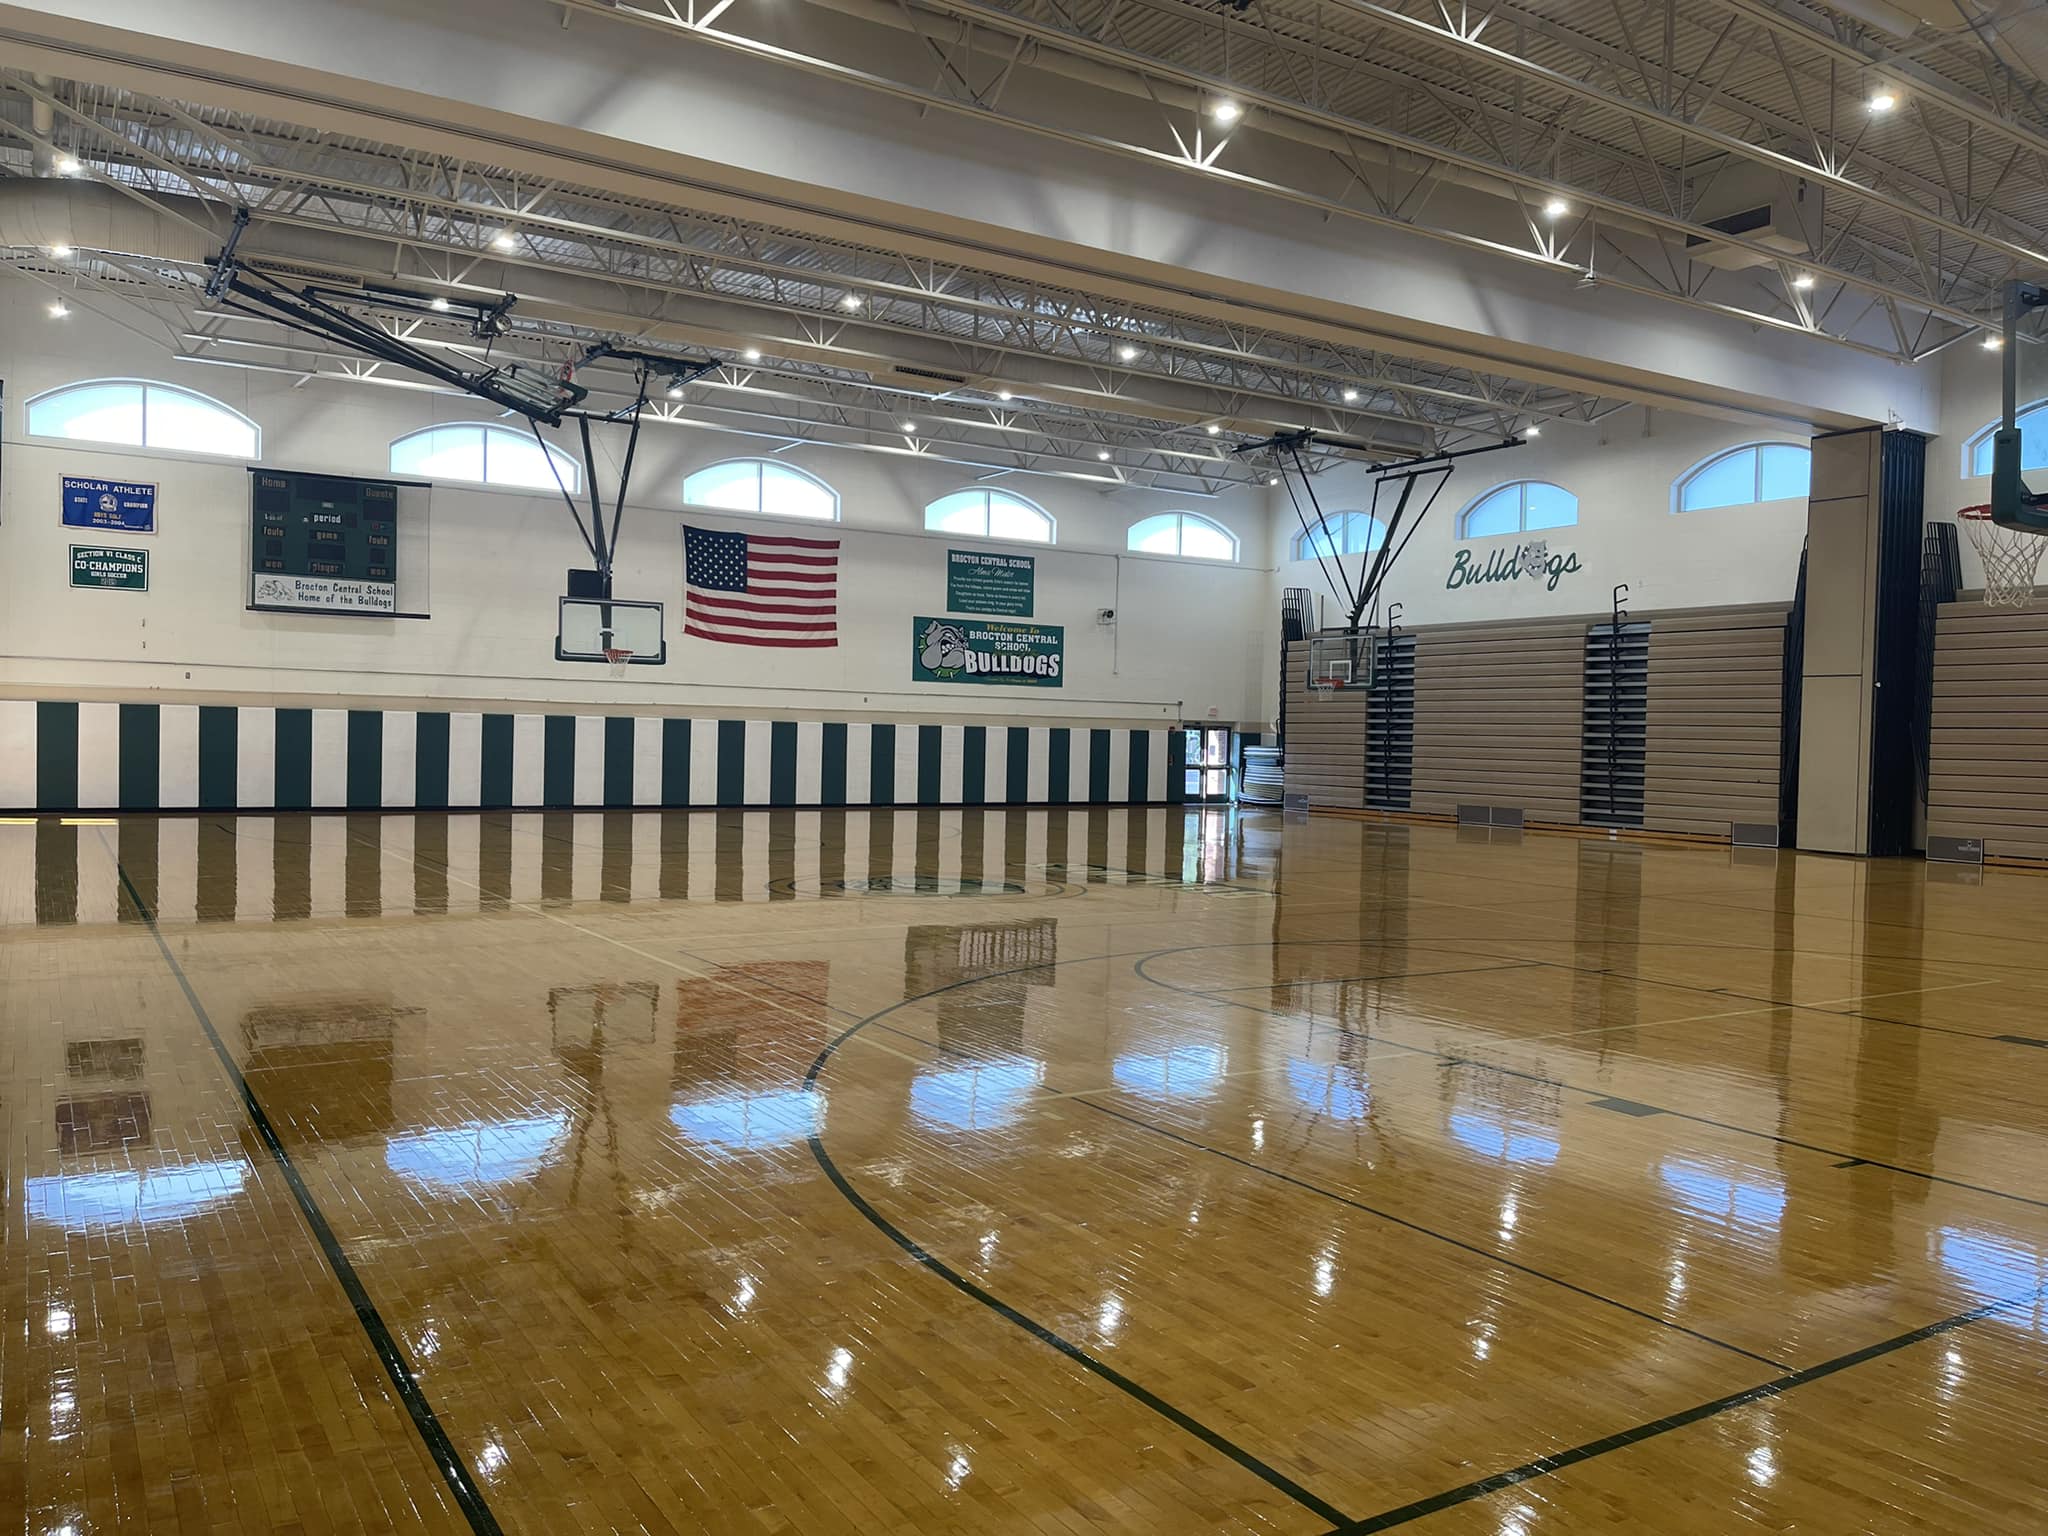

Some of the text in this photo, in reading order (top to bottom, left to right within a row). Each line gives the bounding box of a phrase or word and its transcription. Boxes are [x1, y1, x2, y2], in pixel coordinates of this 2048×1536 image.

[64, 480, 153, 496] SCHOLAR ATHLETE
[262, 477, 286, 488] Home
[313, 513, 341, 524] period
[316, 531, 338, 541] game
[77, 551, 104, 559] SECTION
[115, 552, 136, 562] CLASS
[952, 554, 1032, 569] BROCTON CENTRAL SCHOOL
[74, 560, 144, 574] CO-CHAMPIONS
[1446, 544, 1583, 592] Bulldgs
[295, 580, 393, 596] Brocton Central School
[298, 592, 392, 609] Home of the Bulldogs
[986, 623, 1026, 634] Welcome
[969, 631, 1059, 645] BROCTON CENTRAL
[994, 641, 1031, 652] SCHOOL
[964, 650, 1061, 678] BULLDOGS
